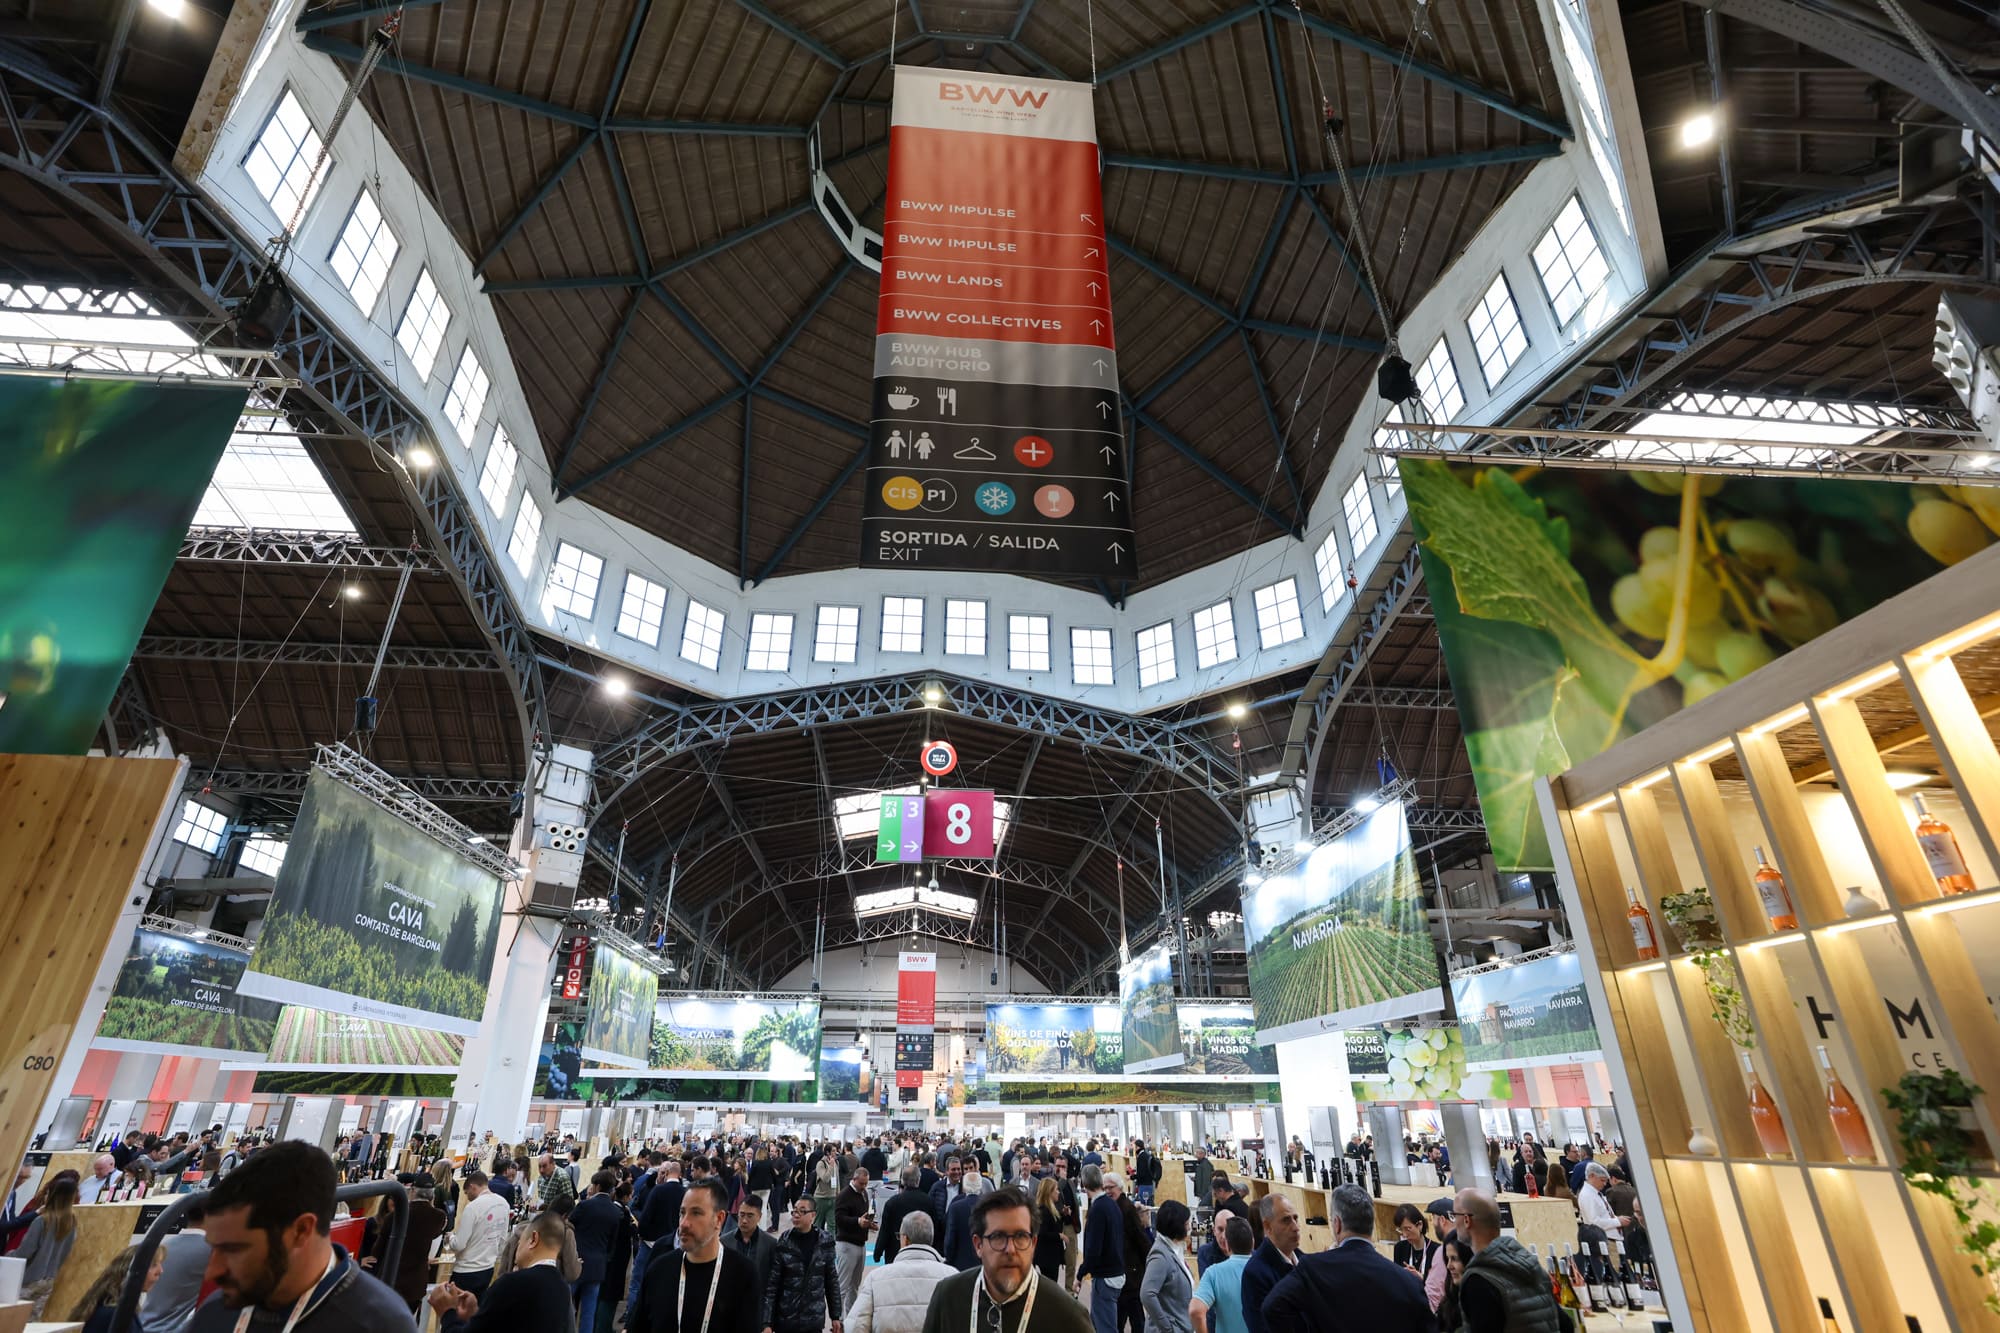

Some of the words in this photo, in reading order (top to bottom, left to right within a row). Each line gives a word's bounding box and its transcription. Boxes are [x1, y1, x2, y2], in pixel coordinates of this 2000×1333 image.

[938, 82, 1049, 109] BWW
[900, 200, 944, 212] BWW
[948, 204, 1016, 218] IMPULSE
[898, 234, 943, 247] BWW
[947, 238, 1017, 252] IMPULSE
[896, 270, 942, 284] BWW
[947, 274, 1004, 288] LANDS
[893, 308, 941, 322] BWW
[946, 312, 1062, 330] COLLECTIVES
[891, 342, 940, 356] BWW
[945, 345, 982, 358] HUB
[890, 355, 991, 373] AUDITORIO
[888, 487, 918, 500] CIS
[927, 489, 946, 502] P1
[879, 530, 968, 547] SORTIDA
[972, 533, 984, 549] /
[988, 535, 1060, 551] SALIDA
[879, 547, 923, 561] EXIT
[907, 801, 919, 818] 3
[946, 803, 972, 845] 8
[388, 901, 423, 931] CAVA
[355, 913, 390, 934] COMTATS
[390, 926, 401, 938] DE
[401, 931, 441, 953] BARCELONA
[1292, 916, 1343, 951] NAVARRA
[906, 955, 928, 963] BWW
[194, 988, 221, 1004] CAVA
[1545, 996, 1583, 1011] NAVARRA
[170, 998, 197, 1009] COMTATS
[196, 1002, 205, 1010] DE
[205, 1003, 235, 1015] BARCELONA
[1461, 1013, 1490, 1025] NAVARRA
[1503, 1017, 1535, 1030] NAVARRO
[339, 1023, 367, 1032] CAVA
[689, 1031, 716, 1039] CAVA
[1005, 1029, 1026, 1038] VINS
[1029, 1030, 1043, 1038] DE
[1006, 1039, 1074, 1048] QUALIFICADA
[1101, 1035, 1122, 1044] PAG
[1206, 1036, 1237, 1044] VINOS
[1238, 1036, 1252, 1044] DE
[1344, 1035, 1364, 1044] AGO
[1365, 1036, 1379, 1044] DE
[1211, 1045, 1249, 1054] MADRID
[1345, 1045, 1384, 1054] INZANO
